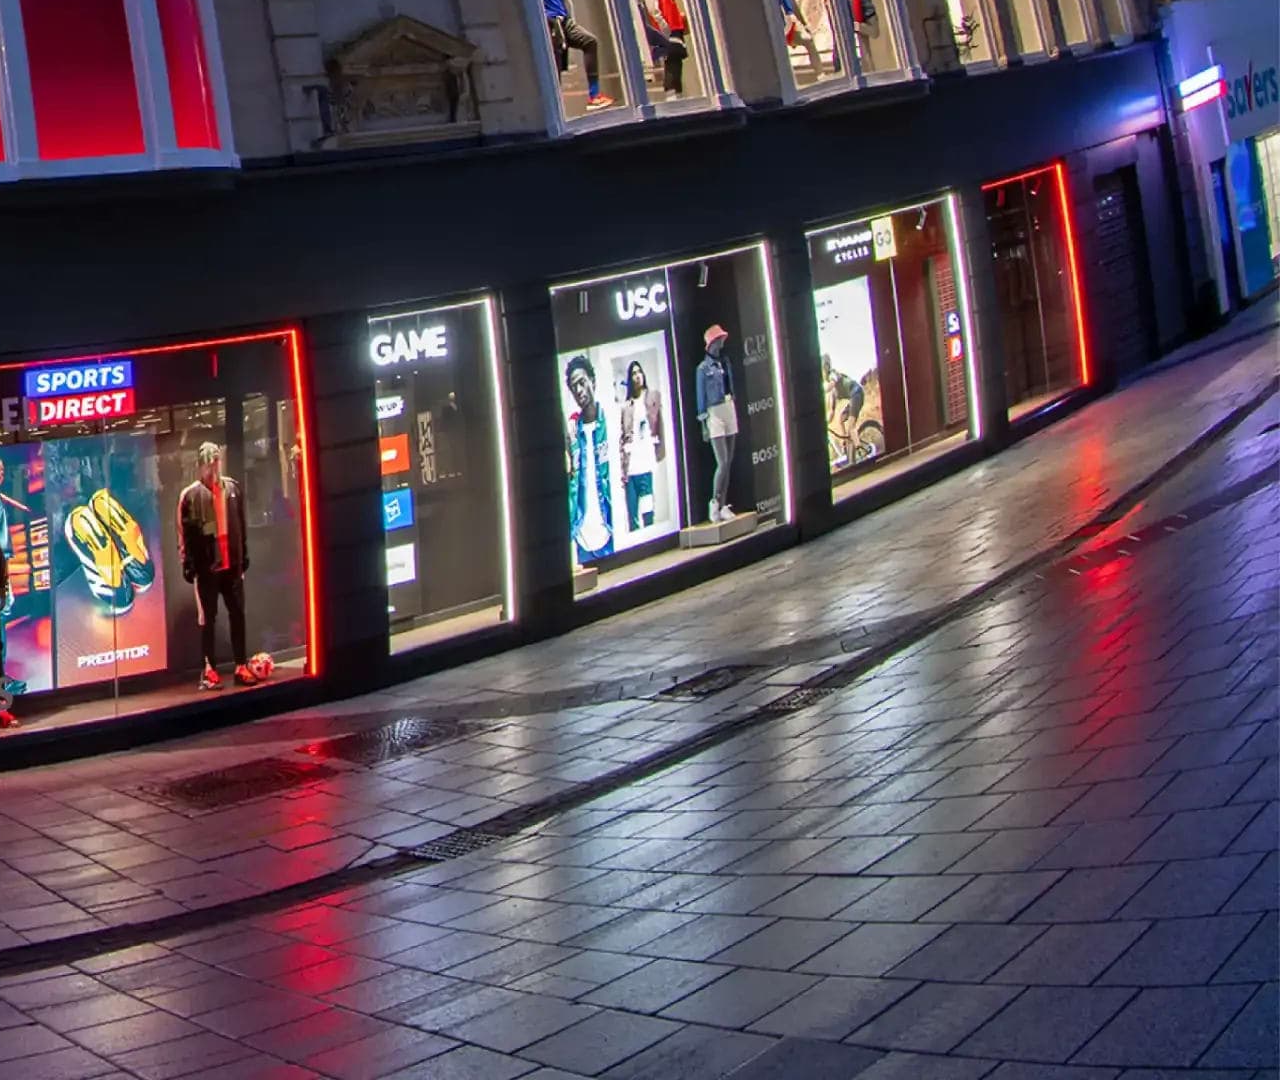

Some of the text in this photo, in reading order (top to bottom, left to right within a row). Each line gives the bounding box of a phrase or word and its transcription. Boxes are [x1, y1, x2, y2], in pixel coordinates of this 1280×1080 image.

[615, 283, 668, 320] USC
[370, 326, 447, 366] GAME
[37, 366, 124, 393] SPORTS
[40, 392, 126, 422] DIRECT
[748, 397, 775, 416] HUGO
[752, 444, 779, 465] BOSS
[77, 644, 150, 668] PREDATOR
